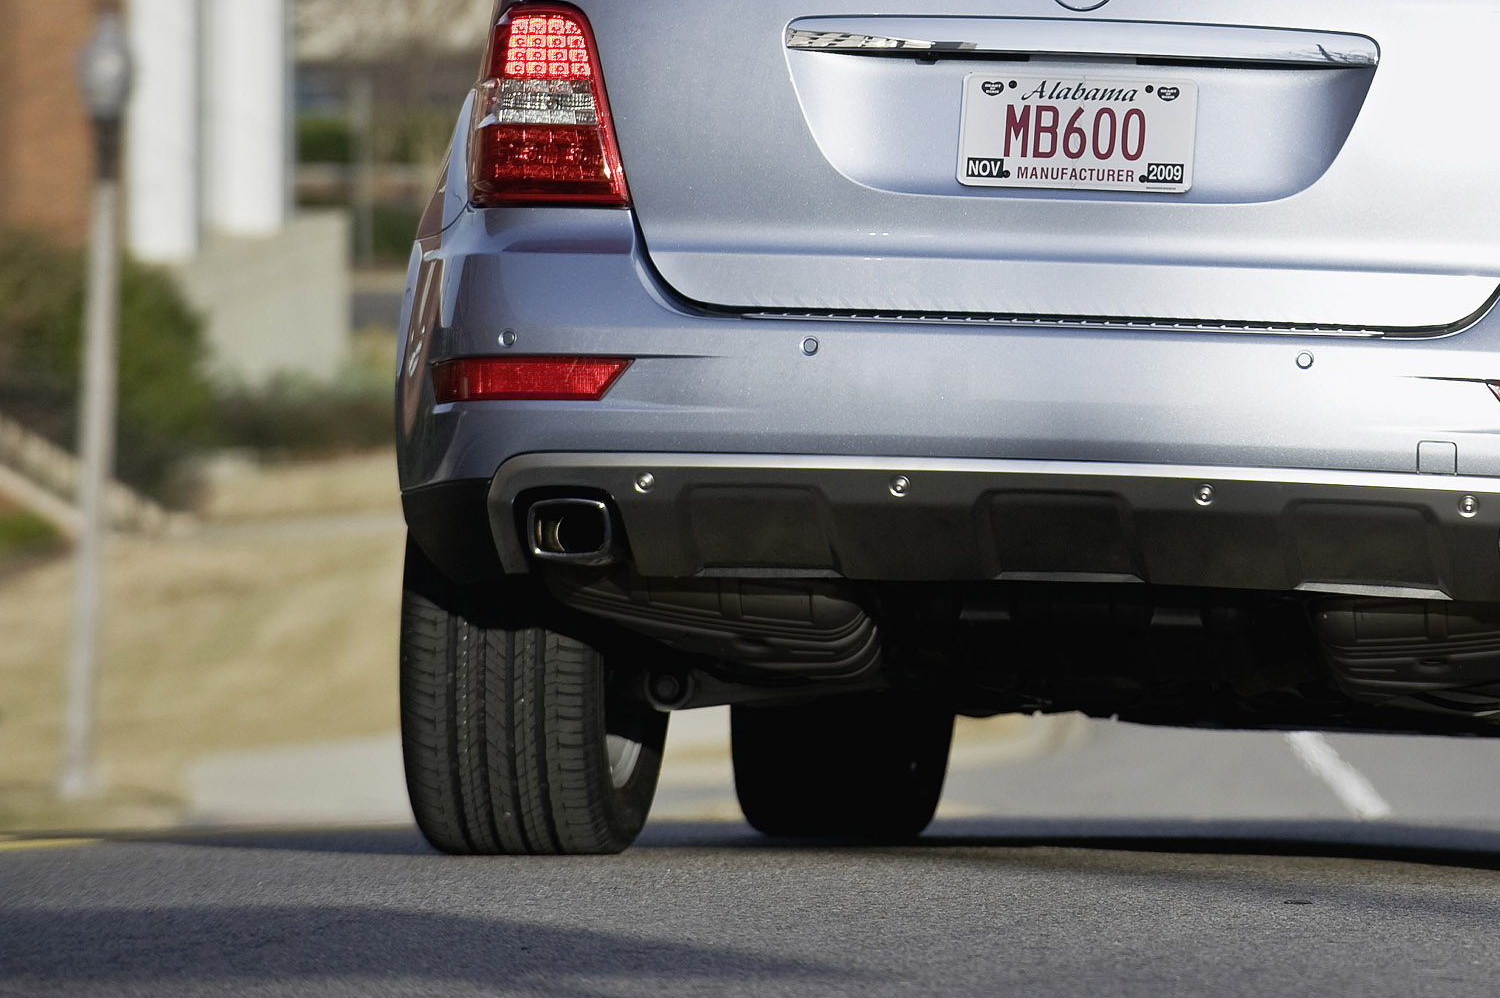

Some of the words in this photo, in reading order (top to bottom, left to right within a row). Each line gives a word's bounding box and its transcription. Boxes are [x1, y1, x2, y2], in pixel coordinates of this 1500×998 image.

[1021, 80, 1139, 102] Alabama
[1003, 104, 1146, 161] MB600
[968, 160, 1001, 177] NOV
[1016, 166, 1135, 183] MANUFACTURER
[1148, 164, 1183, 181] 2009
